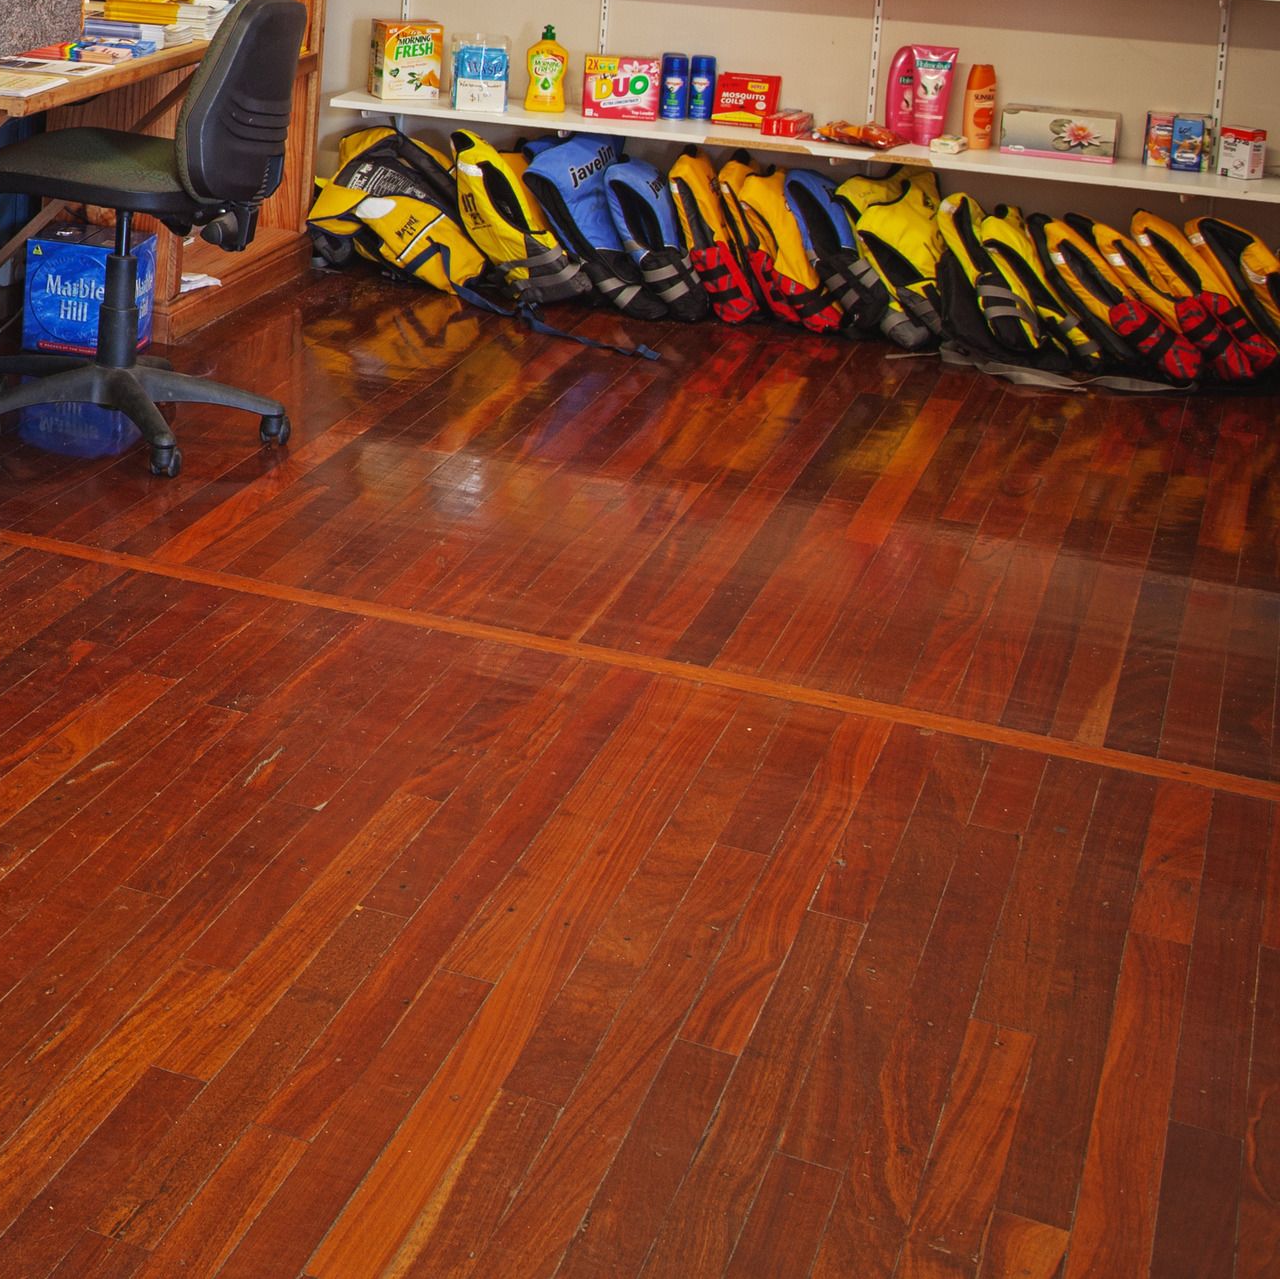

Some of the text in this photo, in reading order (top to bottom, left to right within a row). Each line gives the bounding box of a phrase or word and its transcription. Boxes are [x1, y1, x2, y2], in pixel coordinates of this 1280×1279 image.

[398, 34, 431, 45] MORNING
[395, 43, 434, 60] FRESH
[587, 58, 599, 71] 2X
[594, 74, 649, 100] DUO
[720, 97, 744, 105] COILS
[722, 91, 766, 101] MOSQUITO
[569, 145, 616, 187] javelin
[46, 274, 104, 300] Marble
[59, 299, 88, 322] Hill
